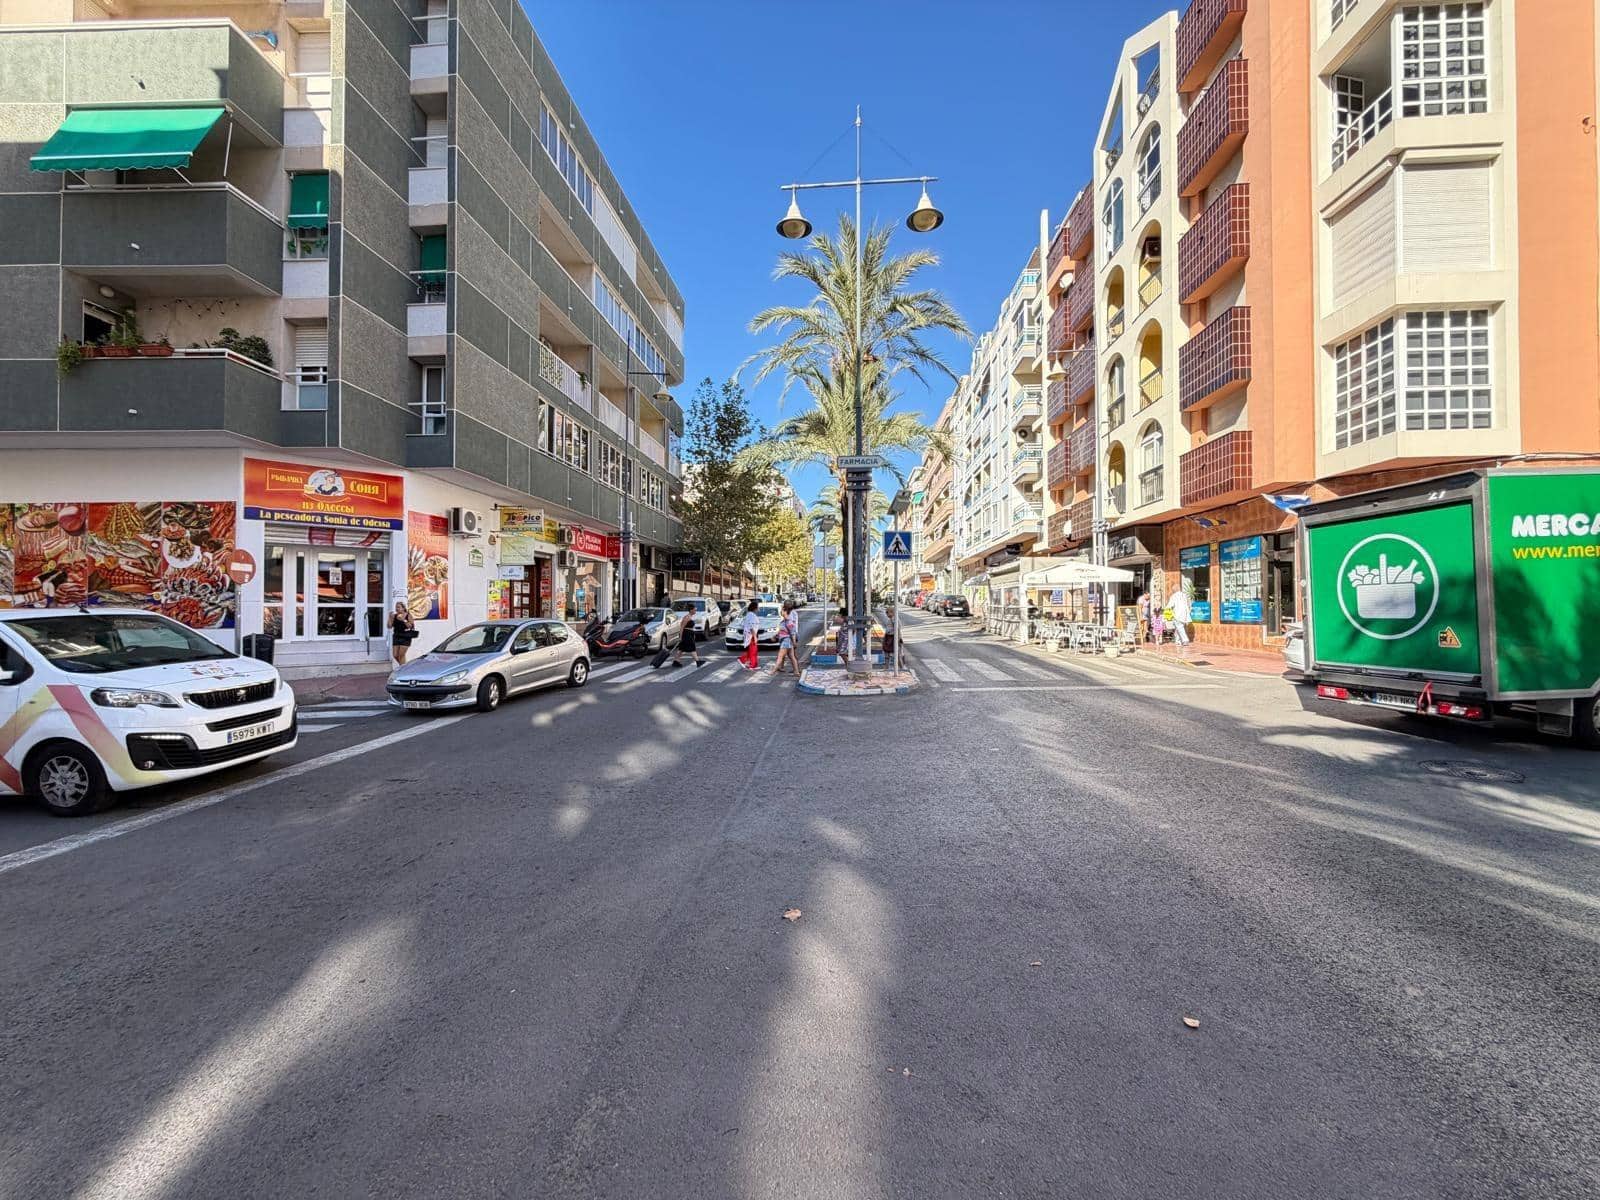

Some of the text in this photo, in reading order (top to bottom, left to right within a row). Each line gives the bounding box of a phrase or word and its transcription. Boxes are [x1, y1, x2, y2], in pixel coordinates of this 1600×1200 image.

[259, 510, 391, 528] La pescadora Sonia de Odessa
[232, 728, 255, 741] 5979
